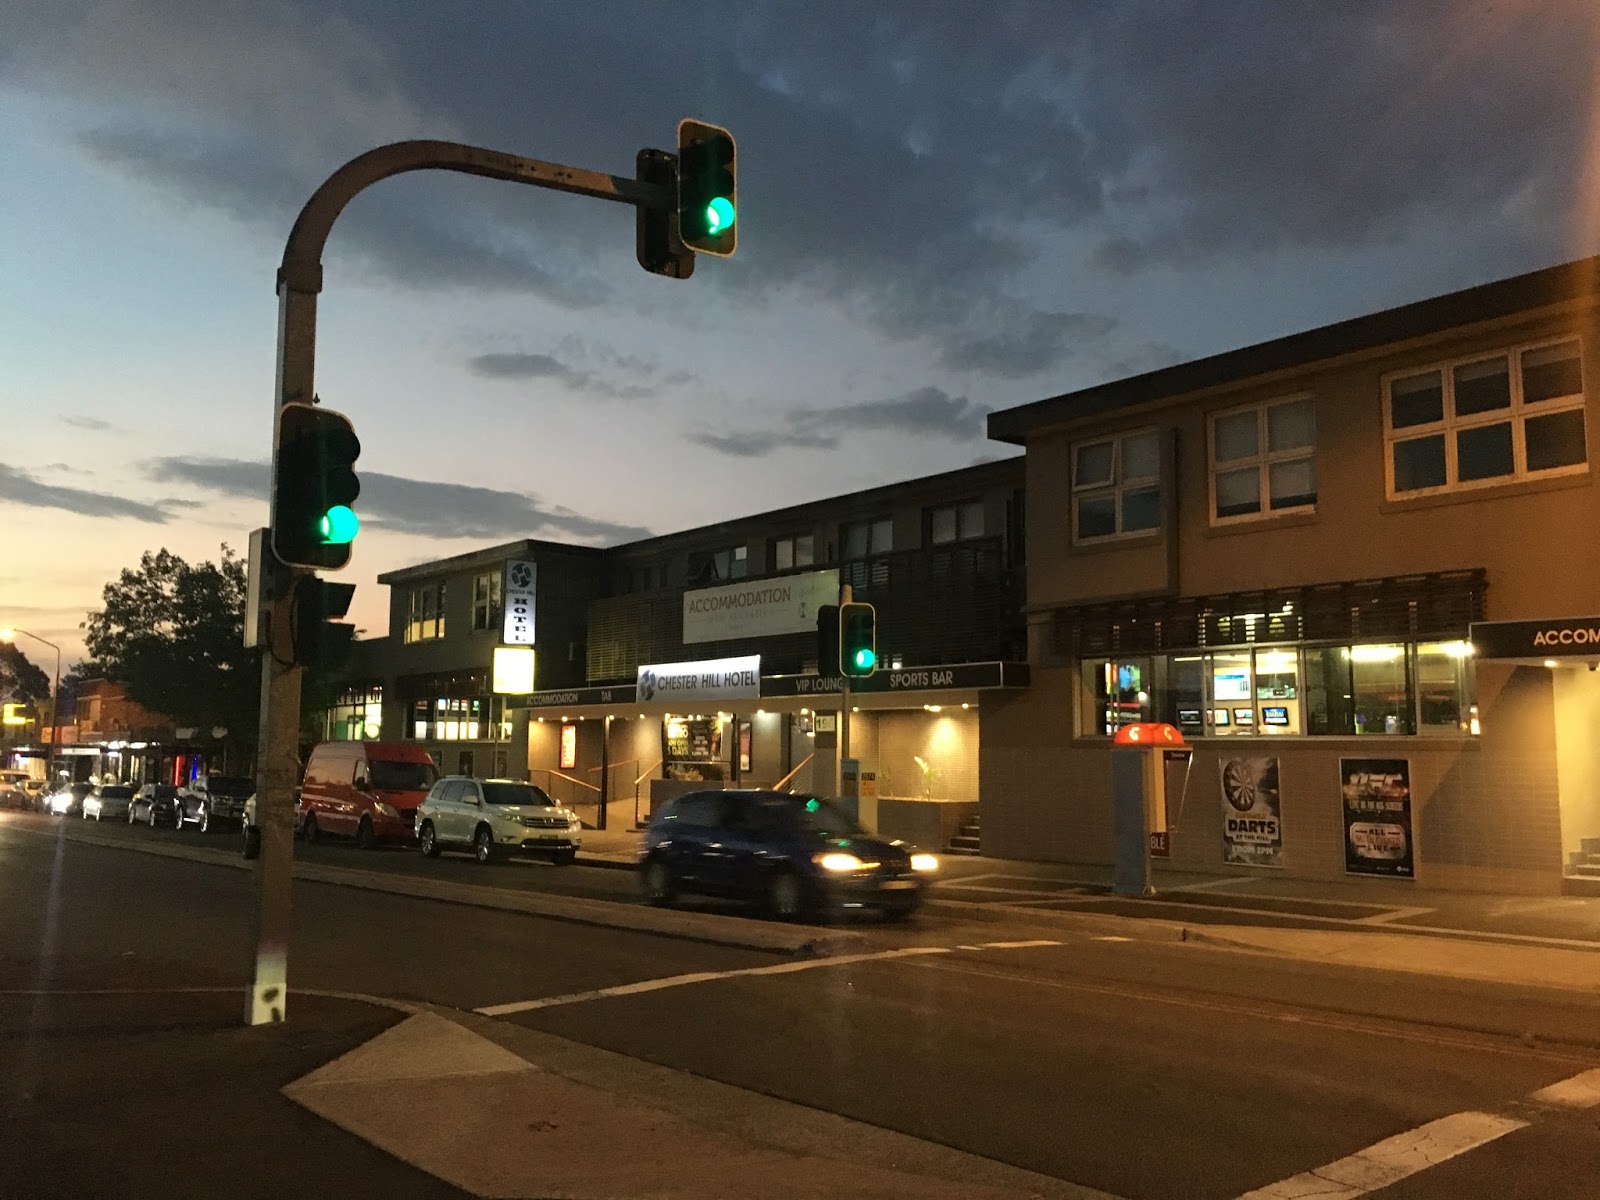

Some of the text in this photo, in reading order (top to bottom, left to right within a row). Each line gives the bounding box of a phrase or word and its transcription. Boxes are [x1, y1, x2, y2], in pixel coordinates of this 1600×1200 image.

[688, 586, 792, 614] ACCOMMODATION
[513, 597, 528, 642] HOTEL
[1533, 628, 1600, 646] ACCOM
[657, 670, 756, 692] CHESTER HILL HOTEL
[796, 677, 843, 692] VIP LOUNG
[889, 670, 953, 688] SPORTS BAR
[526, 692, 578, 705] ACCOMMODATION
[601, 691, 612, 701] TAB
[1228, 819, 1276, 833] DARTS
[1368, 828, 1386, 836] ALL
[1231, 844, 1274, 855] FROM 2PM
